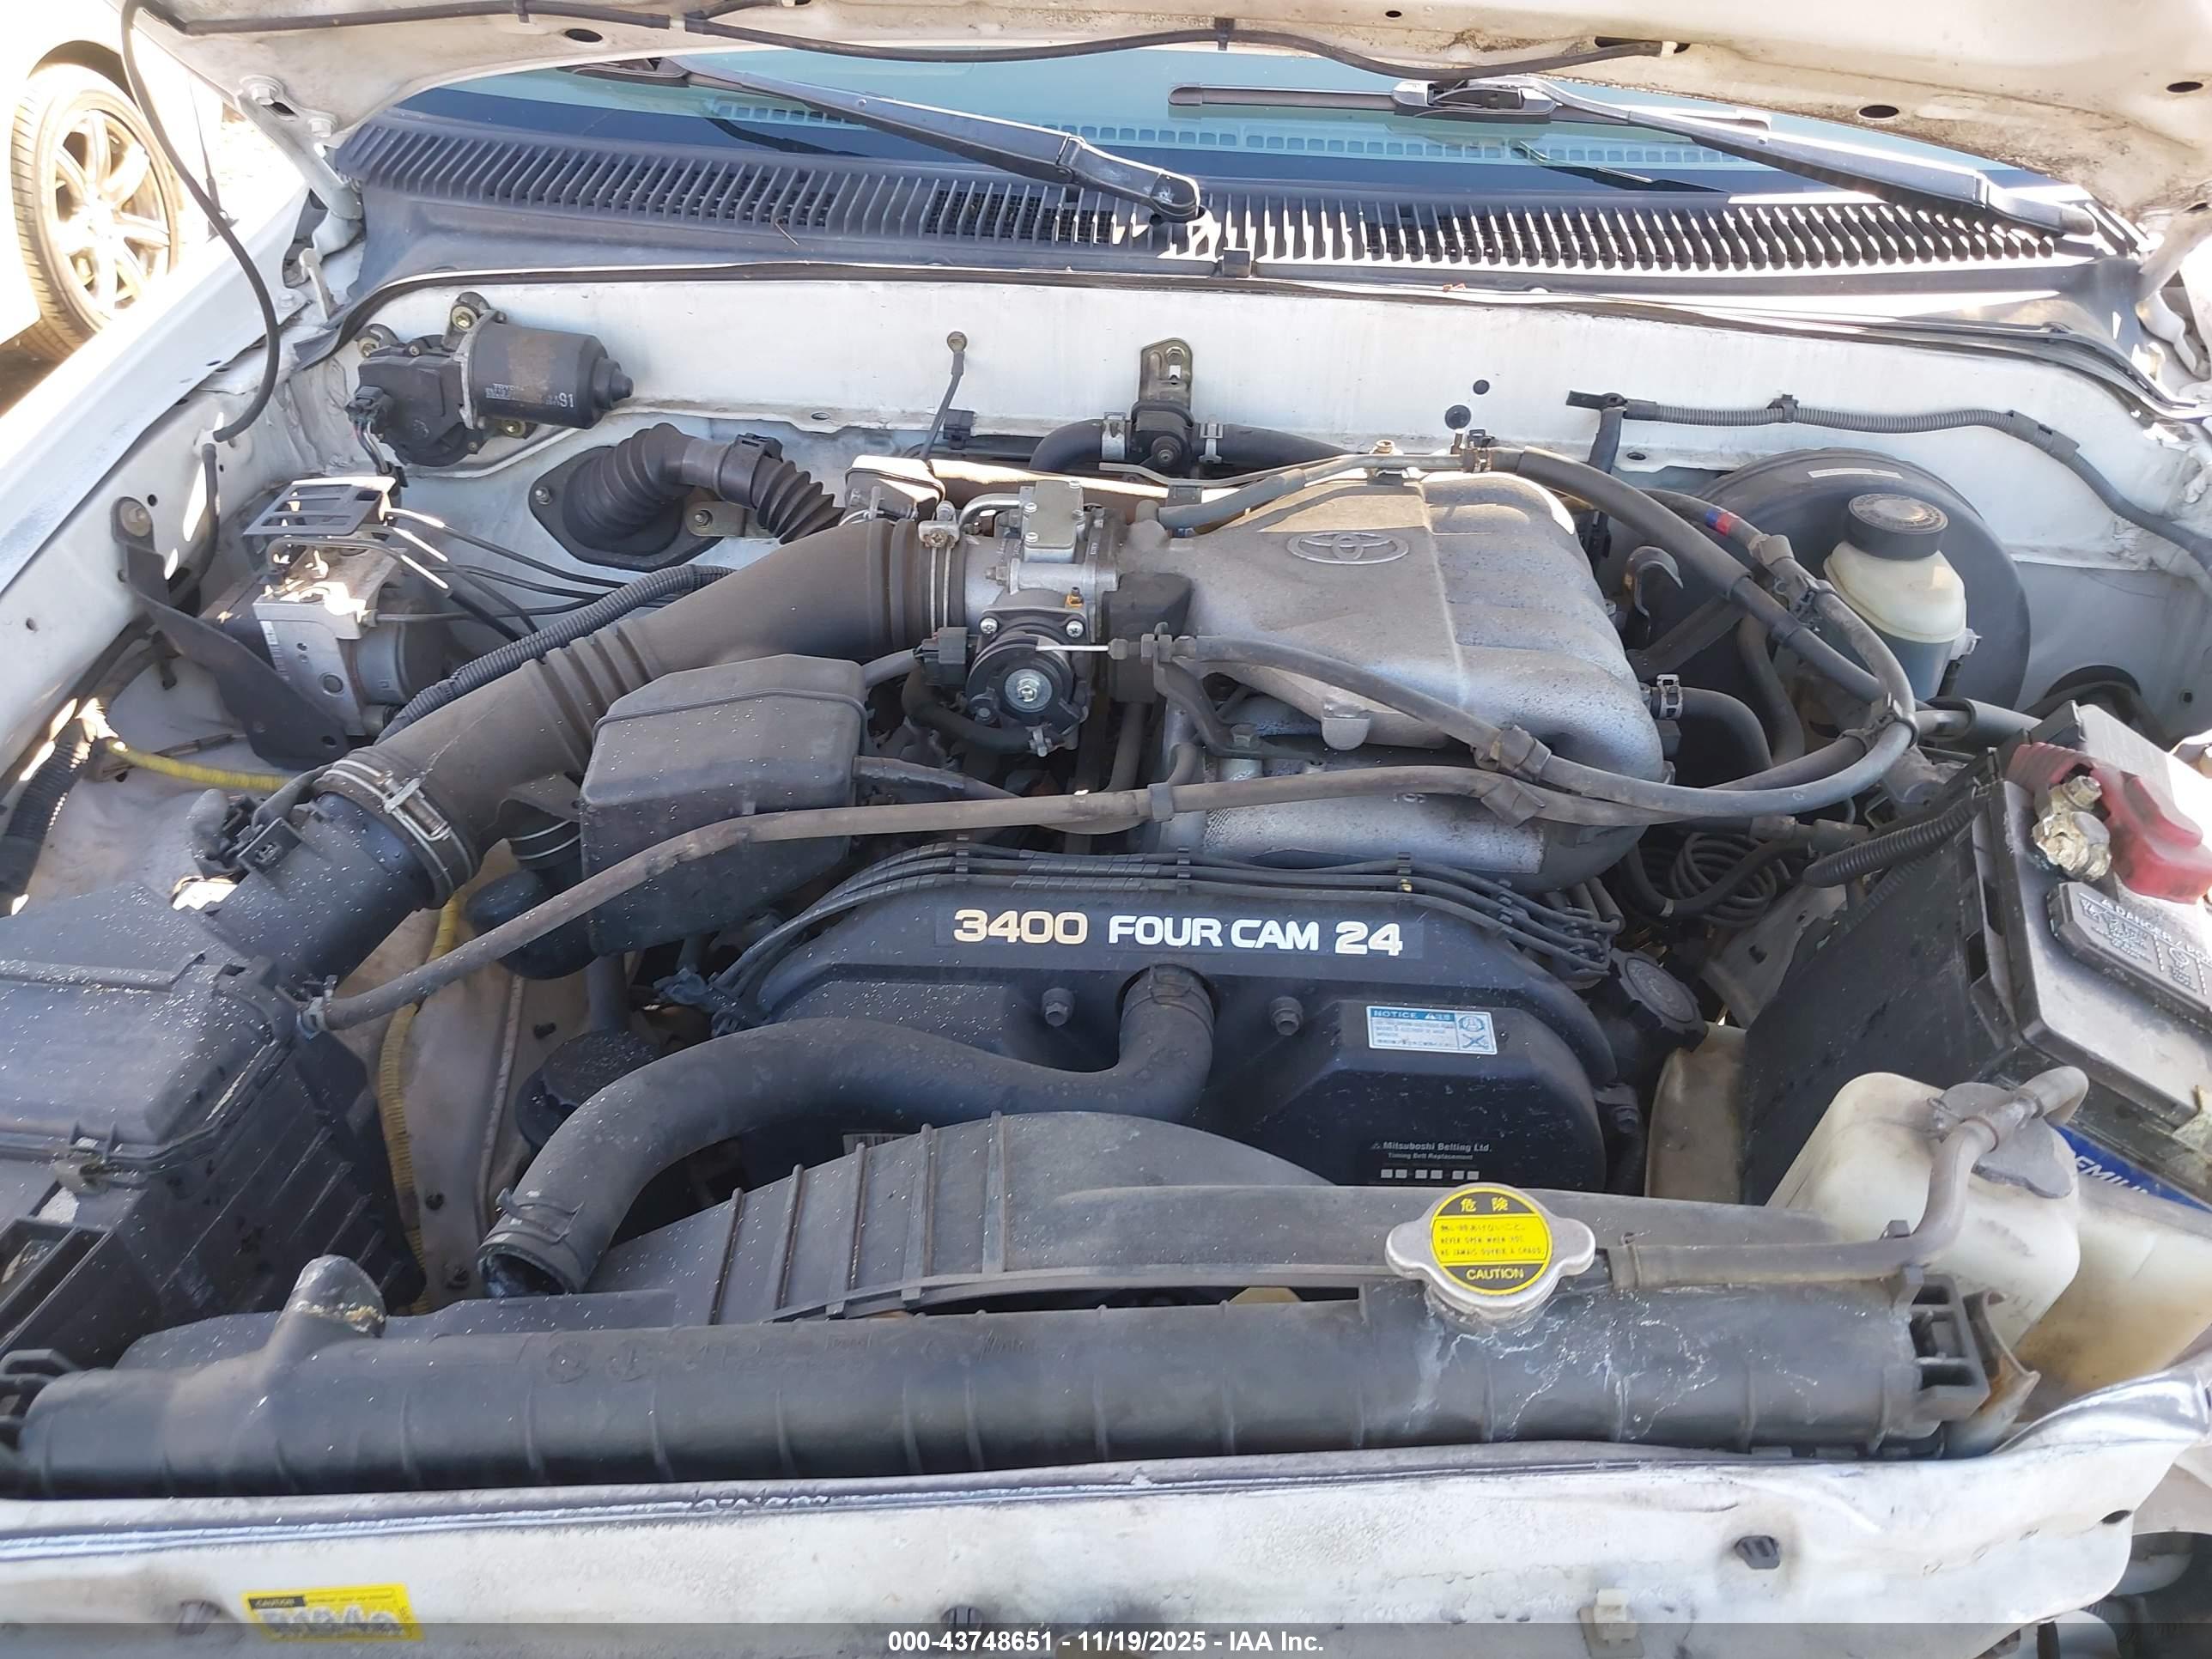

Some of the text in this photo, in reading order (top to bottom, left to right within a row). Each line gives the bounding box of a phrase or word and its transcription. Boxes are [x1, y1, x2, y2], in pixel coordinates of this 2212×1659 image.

[953, 908, 1403, 957] 3400 FOUR CAM 24
[1373, 1010, 1418, 1018] NOTICE
[1382, 1140, 1492, 1152] Mitsuboshi Belting Ltd.
[1466, 1267, 1525, 1280] CAUTION
